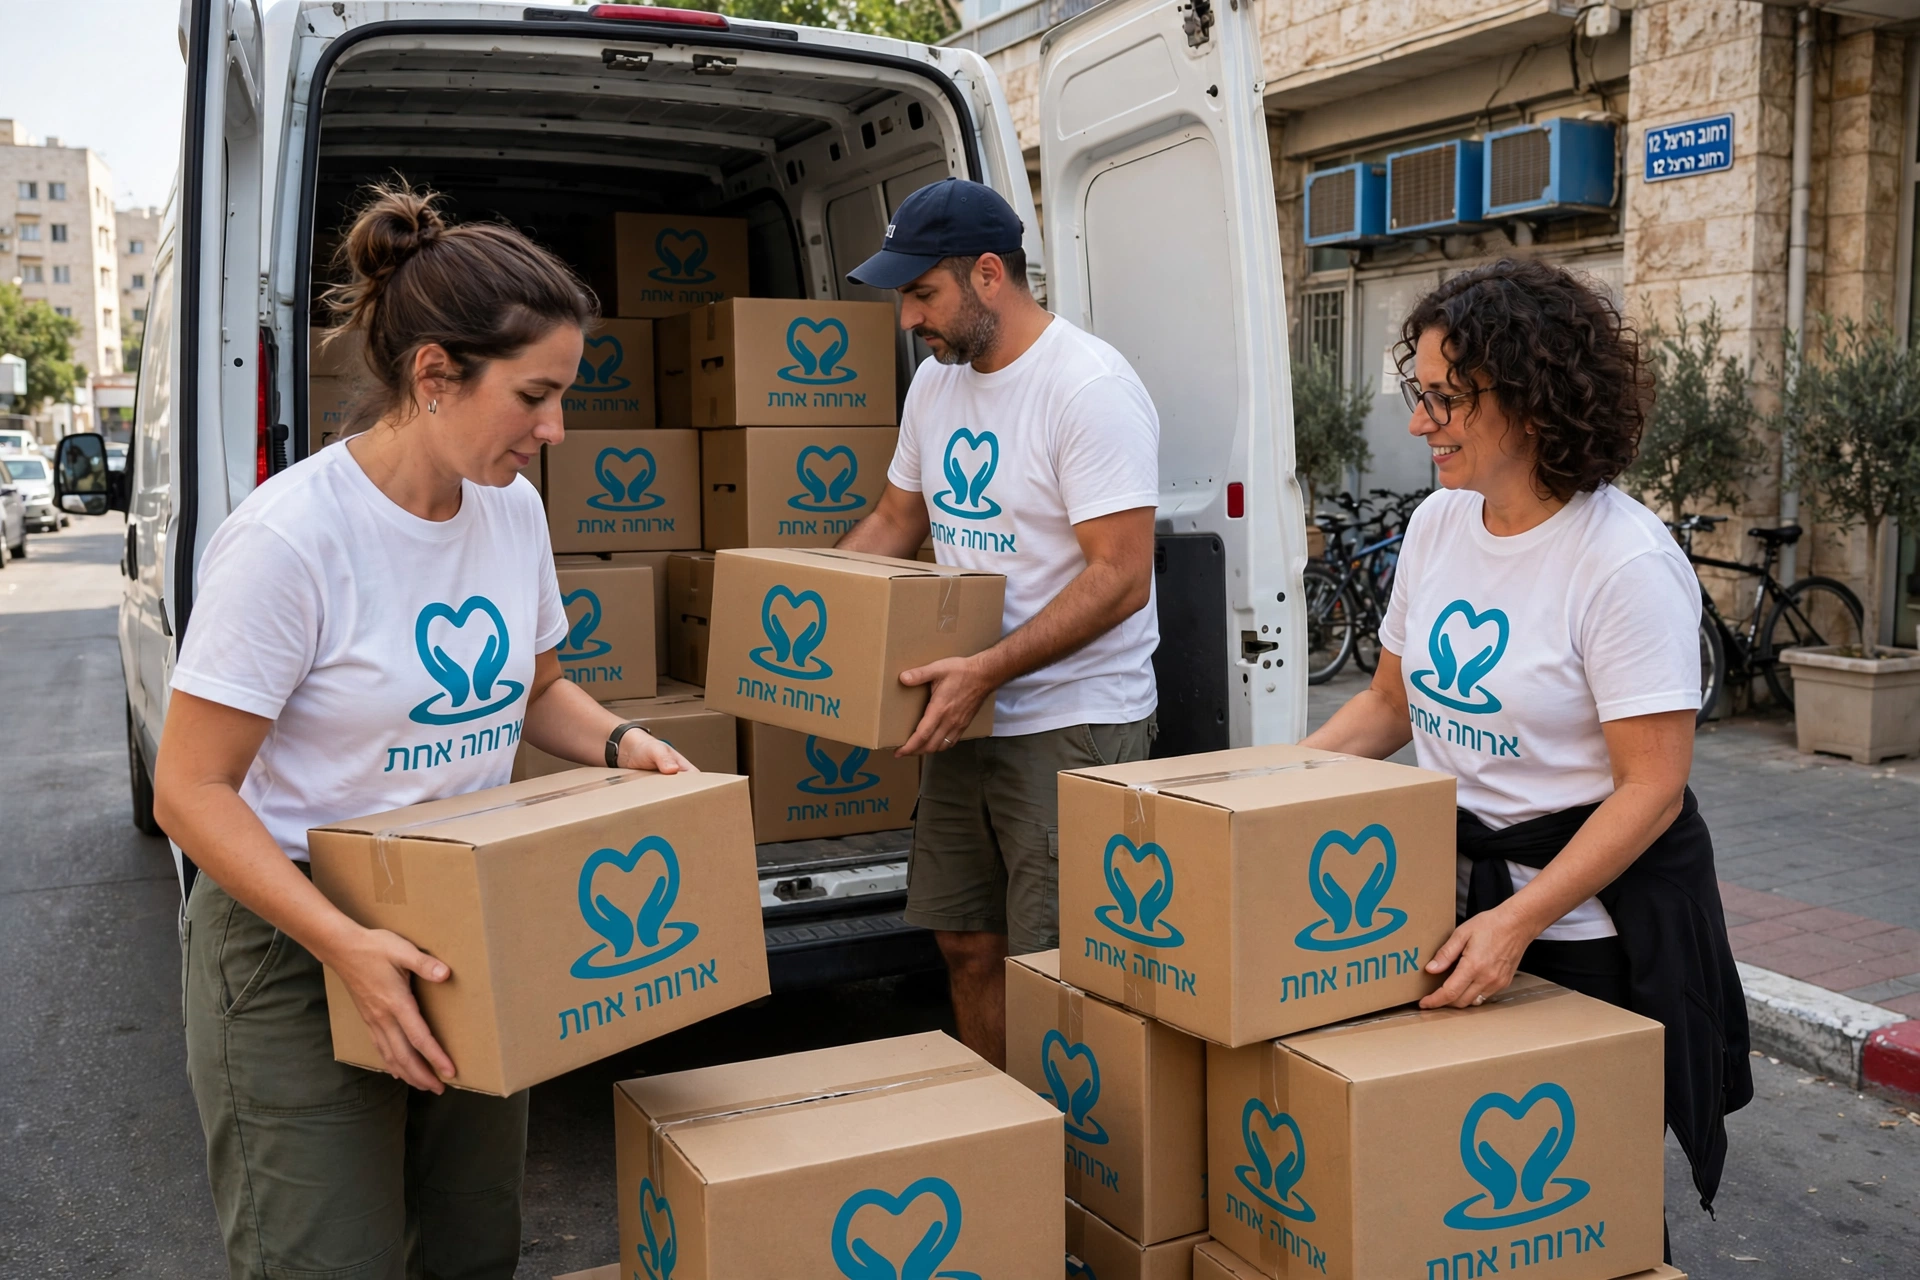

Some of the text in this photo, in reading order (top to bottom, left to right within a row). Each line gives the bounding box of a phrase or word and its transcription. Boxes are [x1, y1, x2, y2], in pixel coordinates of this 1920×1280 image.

[1648, 124, 1727, 154] רחוב הרצל 12
[1652, 159, 1665, 175] 12
[1698, 151, 1725, 168] רחוב
[640, 289, 724, 303] ארוחה אחת
[562, 397, 640, 412] ארוחה אח
[767, 392, 867, 408] ארוחה אחת
[577, 517, 675, 534] ארוחה אחת
[778, 520, 817, 535] אחת
[931, 521, 1017, 553] ארוחה אחת
[736, 676, 841, 719] ארוחה אחת
[384, 718, 524, 773] ארוחה אחת
[1409, 703, 1521, 758] ארוחה אחת
[786, 796, 889, 822] ארוחה אחת
[1084, 936, 1197, 997] ארוחה אחת
[1280, 946, 1420, 1003] ארוחה אחת
[558, 958, 719, 1041] ארוחה אחת
[1065, 1143, 1120, 1194] ארוחה
[1226, 1192, 1327, 1276] ארוחה אחת
[1426, 1220, 1606, 1280] ארוחה אחת
